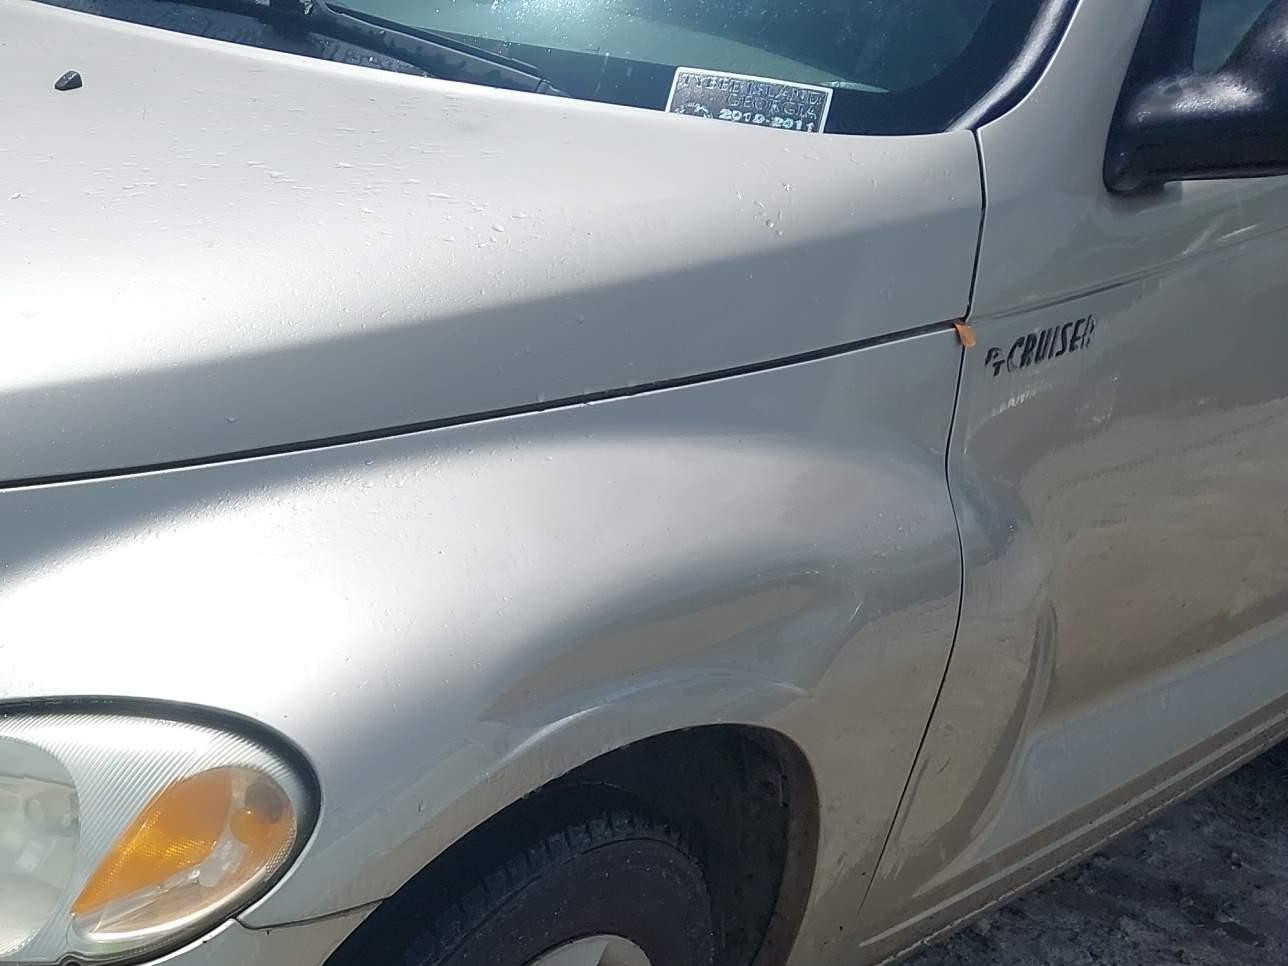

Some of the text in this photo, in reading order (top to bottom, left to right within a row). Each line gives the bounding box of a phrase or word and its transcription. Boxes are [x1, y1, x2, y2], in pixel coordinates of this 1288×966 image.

[679, 73, 740, 93] TYBEE
[727, 93, 817, 120] GEORGIA
[1006, 314, 1096, 373] CRUISER
